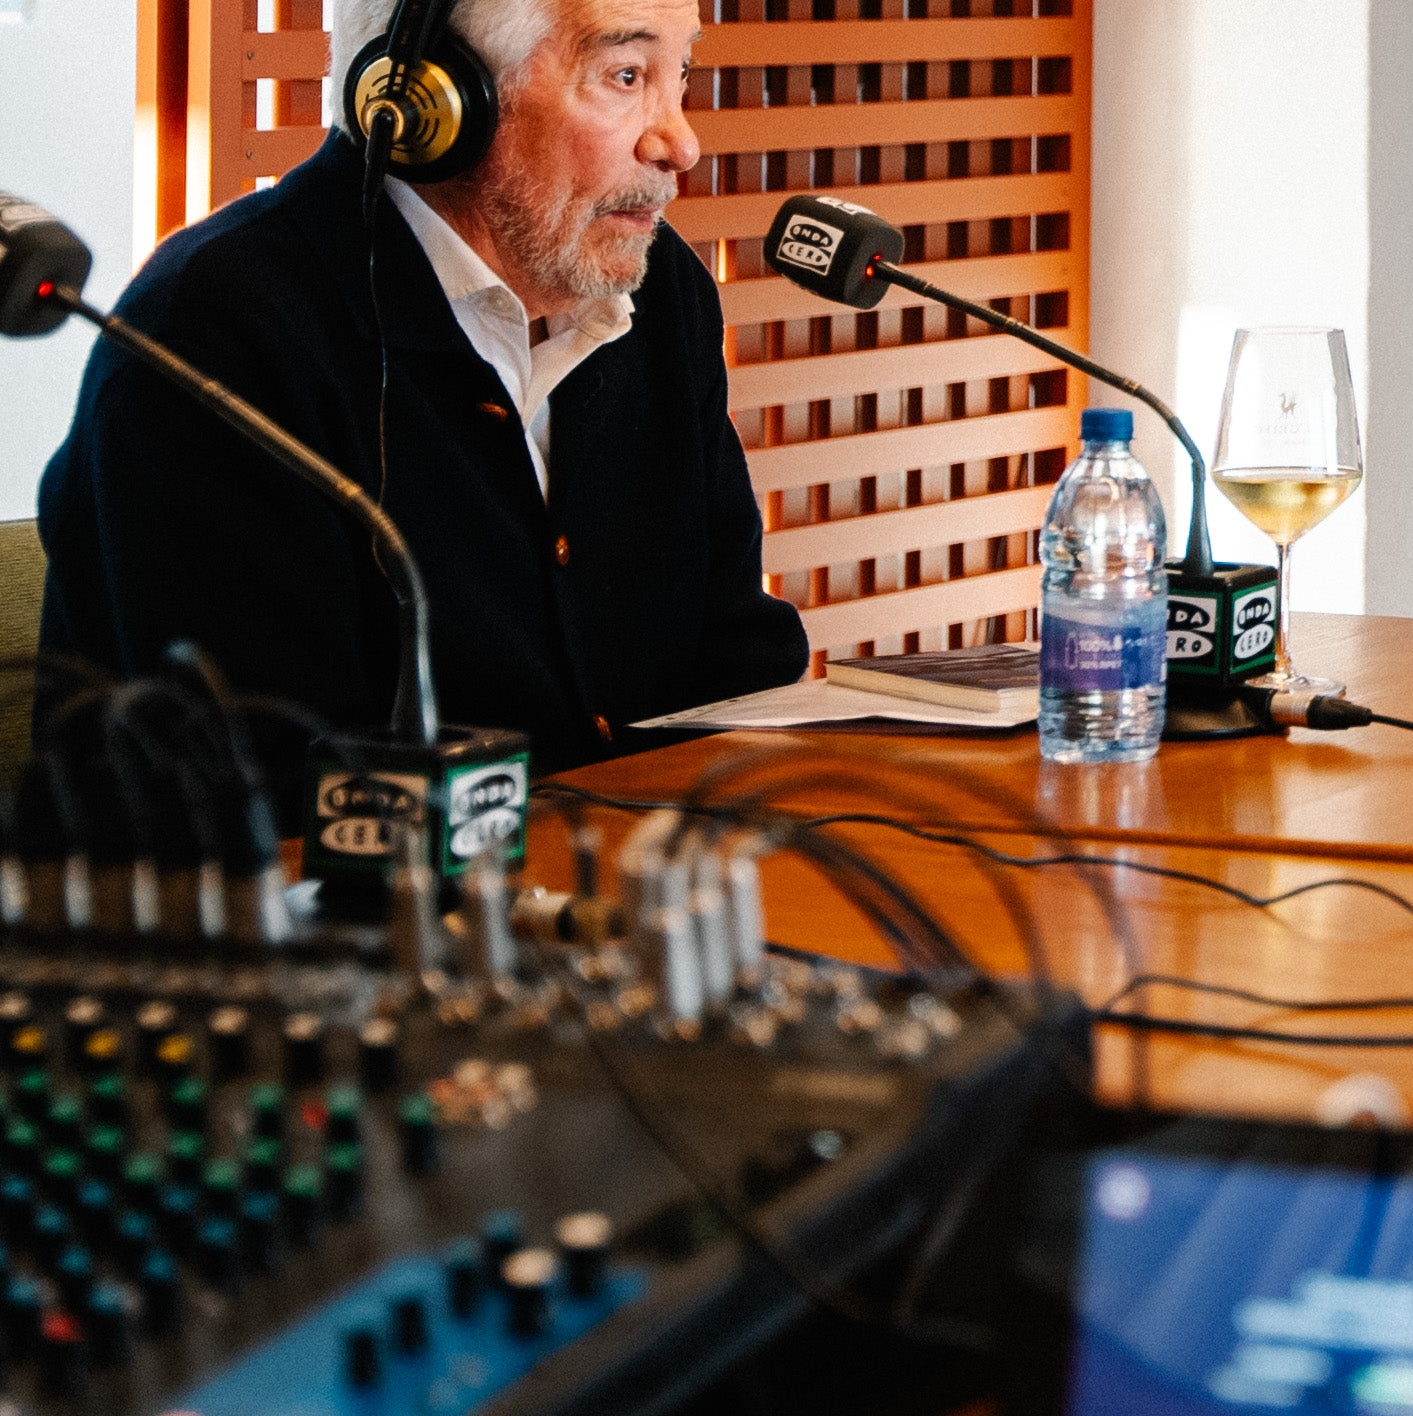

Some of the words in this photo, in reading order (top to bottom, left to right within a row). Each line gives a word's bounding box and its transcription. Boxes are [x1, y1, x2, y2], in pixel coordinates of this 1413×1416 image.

[792, 224, 830, 246] ONDA
[788, 244, 823, 263] CERO
[1166, 609, 1203, 624] DA
[1175, 637, 1202, 653] RO
